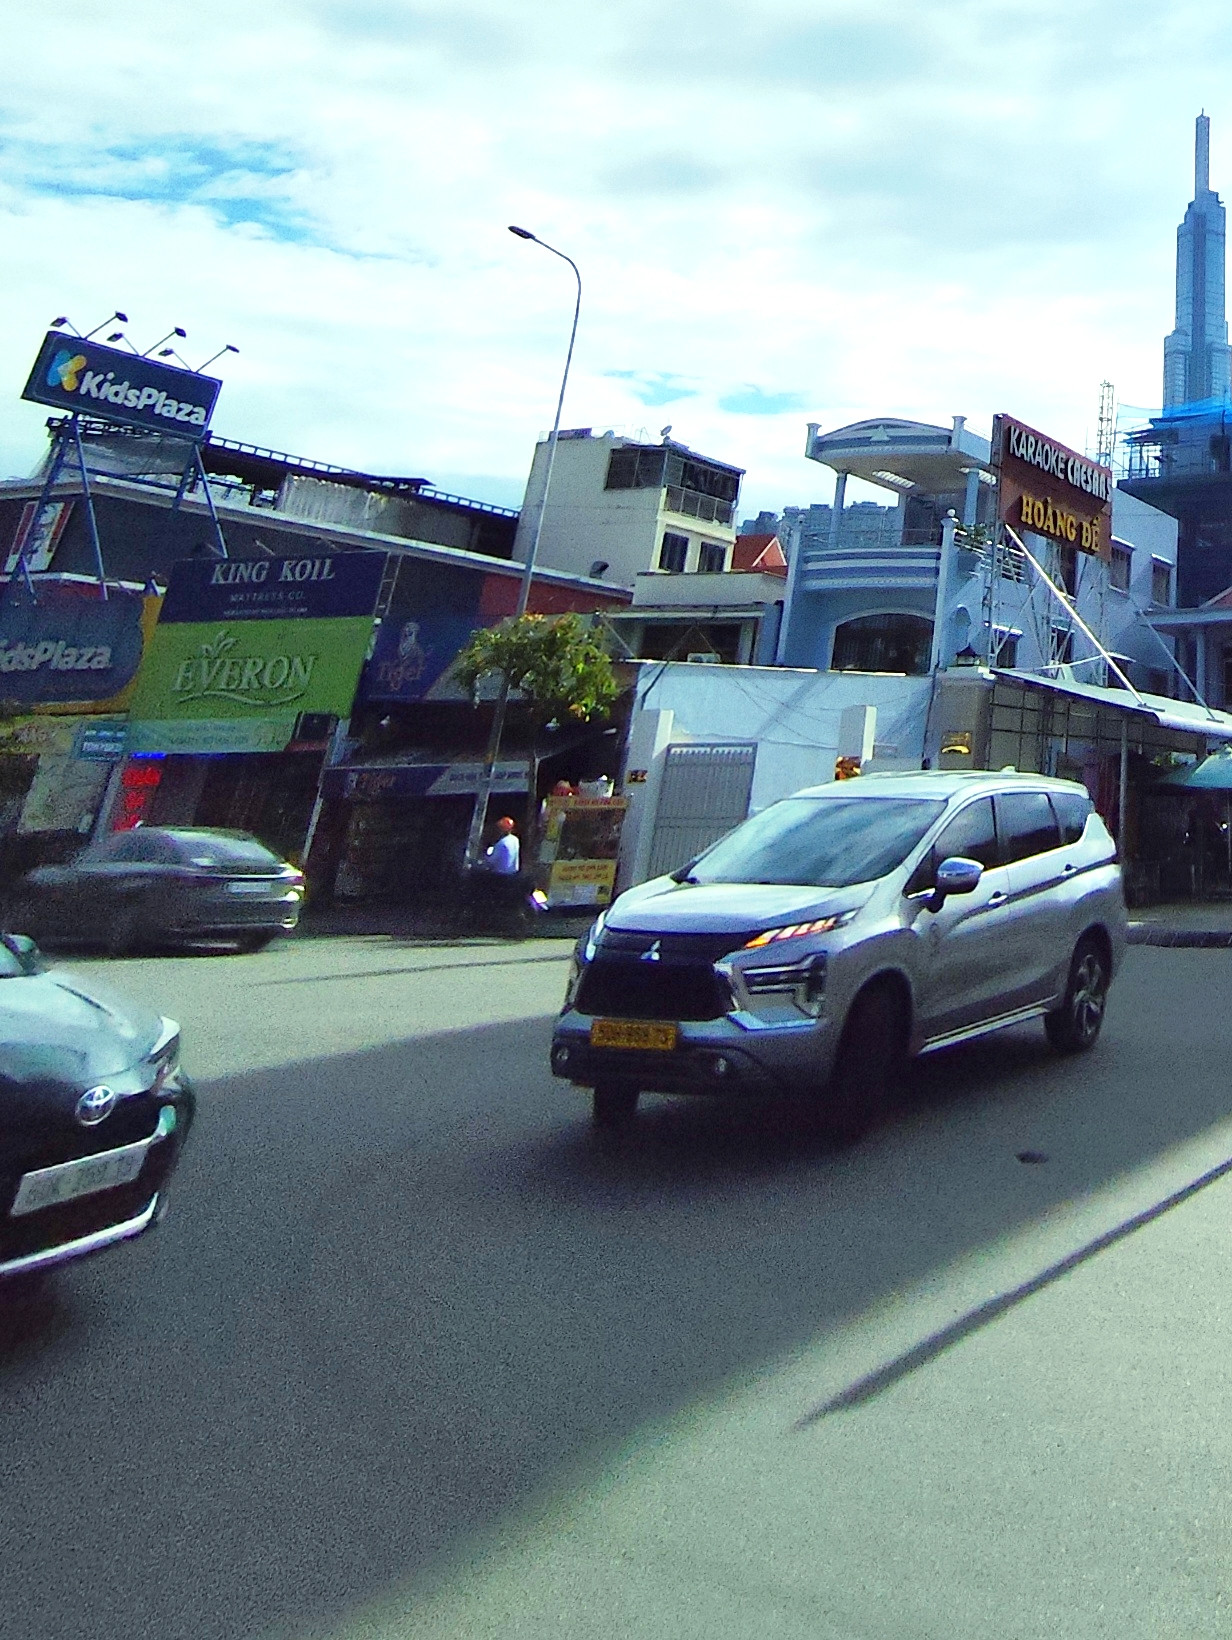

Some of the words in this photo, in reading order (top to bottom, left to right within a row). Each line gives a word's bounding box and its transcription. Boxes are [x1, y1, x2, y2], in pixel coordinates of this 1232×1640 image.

[79, 370, 207, 425] KidsPlaza
[1009, 425, 1066, 480] KARAOKE
[1020, 497, 1077, 542] HOÀNG
[211, 561, 271, 584] KING
[278, 558, 336, 582] KOIL
[172, 655, 318, 692] EVERON
